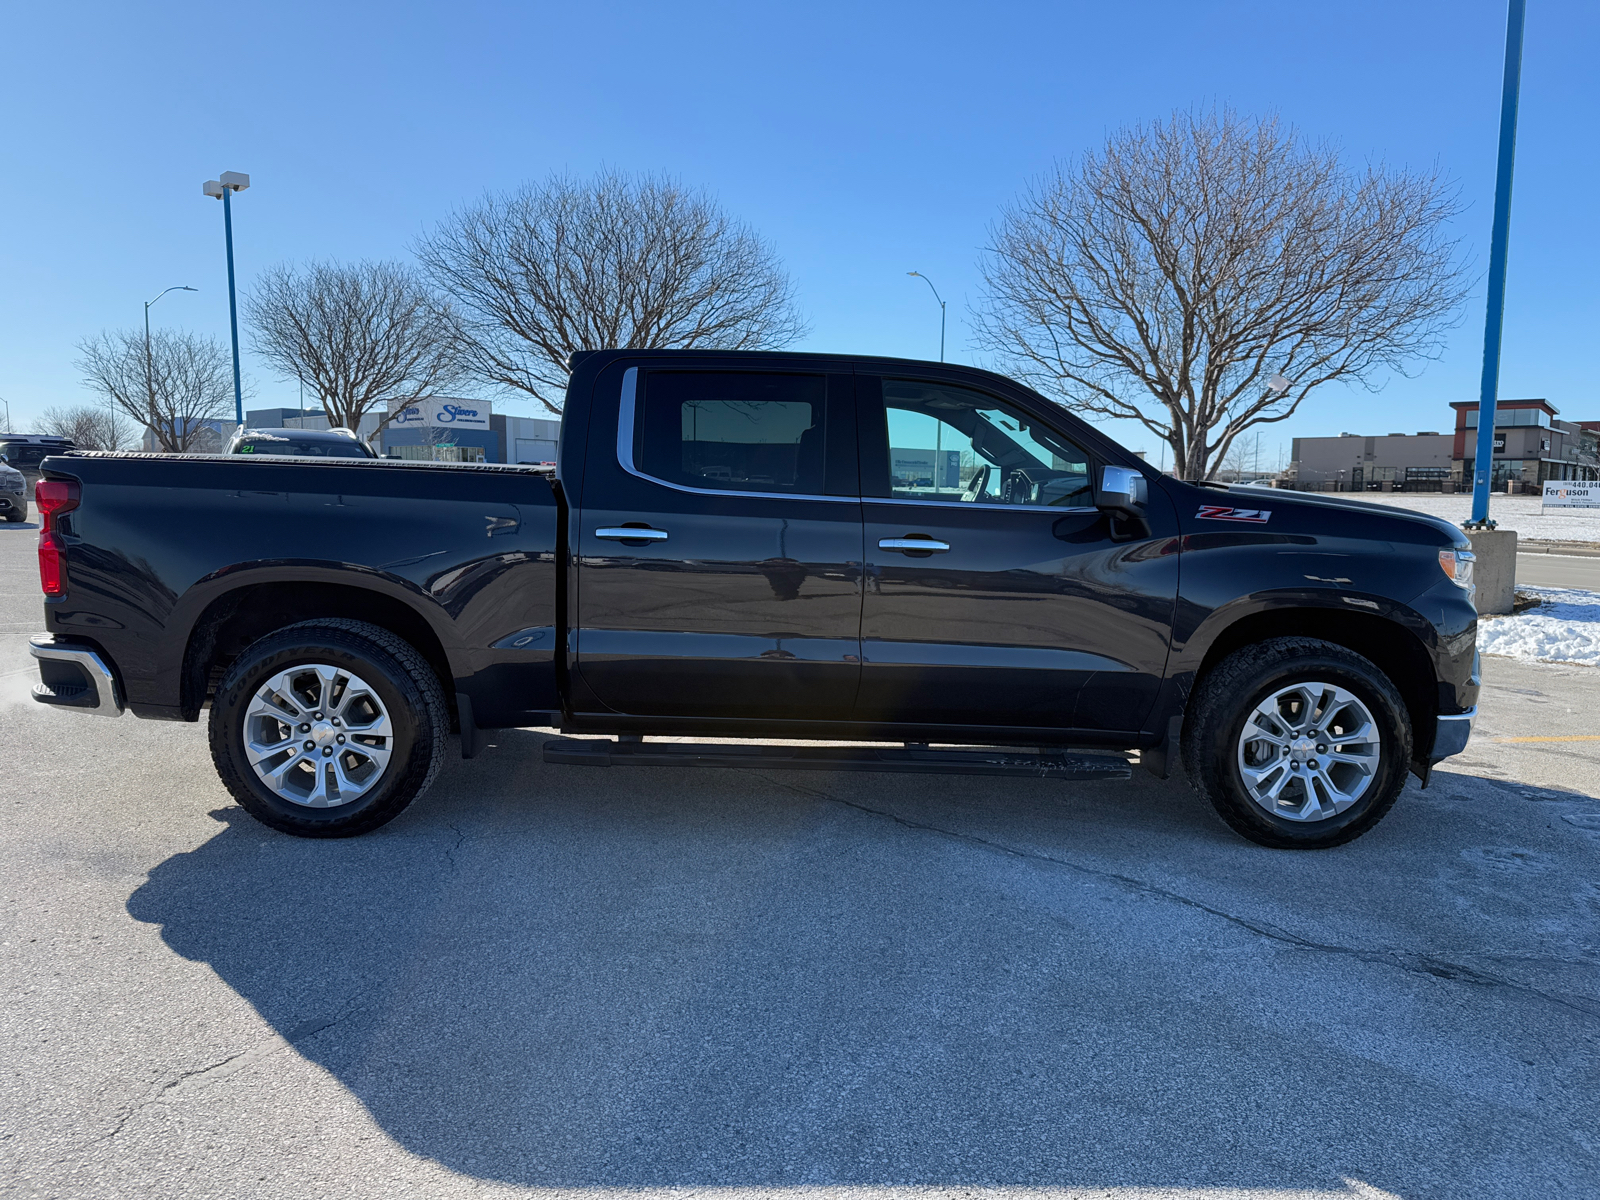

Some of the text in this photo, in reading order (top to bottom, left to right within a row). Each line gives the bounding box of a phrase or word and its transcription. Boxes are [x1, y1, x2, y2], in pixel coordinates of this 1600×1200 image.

[437, 405, 478, 423] Stivers
[242, 445, 254, 453] 21
[1545, 487, 1588, 499] Ferguson
[1195, 505, 1272, 524] Z71
[228, 645, 357, 707] GOODYEAR
